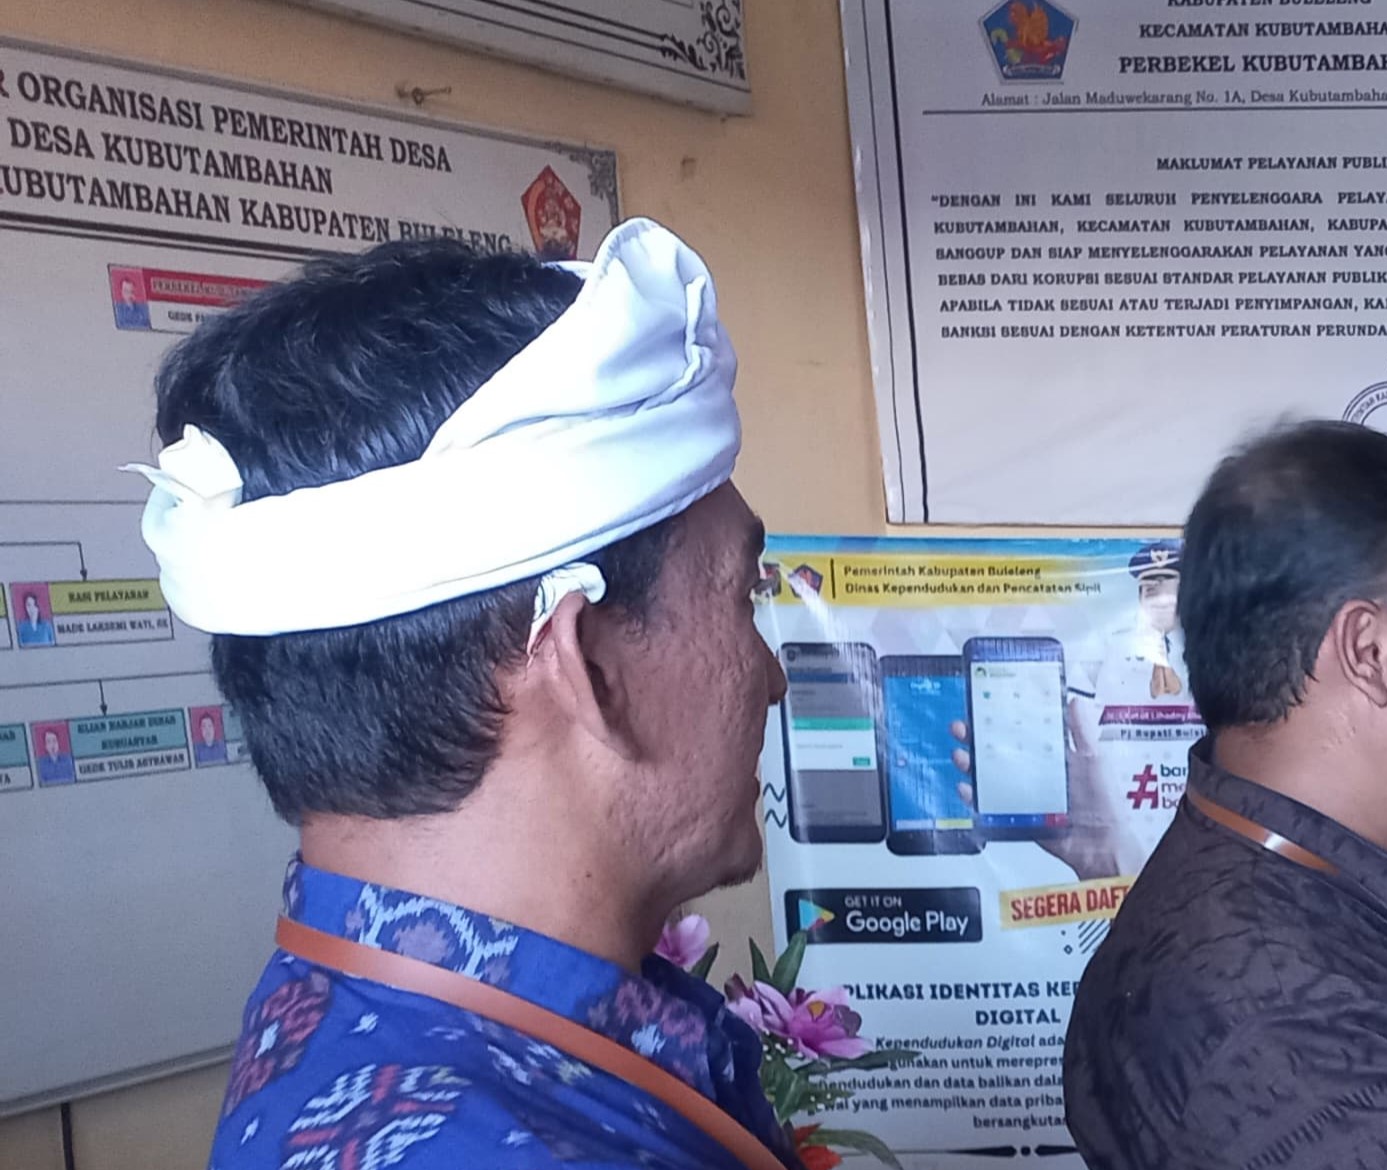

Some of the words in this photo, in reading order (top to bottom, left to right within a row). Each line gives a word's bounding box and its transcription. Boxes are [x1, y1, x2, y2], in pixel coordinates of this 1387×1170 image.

[1139, 22, 1249, 38] KECAMATAN
[1119, 55, 1235, 74] PERBEKEL
[982, 92, 1029, 107] Alamat
[1042, 91, 1081, 106] Jalan
[1086, 89, 1192, 107] Maduwekarang
[1196, 90, 1218, 104] No.
[1251, 89, 1284, 103] Desa
[17, 71, 205, 131] ORGANISASI
[212, 105, 385, 161] PEMERINTAH
[389, 137, 452, 173] DESA
[7, 116, 95, 160] DESA
[101, 132, 333, 195] KUBUTAMBAHAN
[1156, 157, 1243, 170] MAKLUMAT
[1248, 157, 1338, 170] PELAYANAN
[0, 165, 231, 224] UBUTAMBAHAN
[238, 198, 391, 243] KABUPATEN
[1015, 193, 1036, 206] INI
[1051, 193, 1091, 206] KAMI
[1105, 192, 1177, 206] SELURUH
[1191, 191, 1323, 206] PENYELENGGARA
[934, 220, 1065, 235] KUBUTAMBAHAN,
[1077, 219, 1171, 233] KECAMATAN
[1184, 218, 1315, 234] KUBUTAMBAHAN,
[936, 247, 1005, 261] SANGGUP
[1011, 247, 1042, 260] DAN
[1048, 247, 1082, 260] SIAP
[1088, 246, 1253, 260] MENYELENGGARAKAN
[1259, 245, 1349, 259] PELAYANAN
[938, 273, 986, 287] BEBAS
[991, 273, 1028, 286] DARI
[1033, 273, 1099, 286] KORUPSI
[1104, 272, 1158, 285] SESUAI
[1163, 271, 1234, 285] STANDAR
[1238, 271, 1327, 285] PELAYANAN
[1332, 271, 1387, 284] PUBLIK
[939, 299, 1002, 313] APABILA
[1008, 299, 1055, 312] TIDAK
[1060, 298, 1114, 311] SESUAI
[1119, 298, 1159, 311] ATAU
[1164, 298, 1230, 311] TERJADI
[1235, 297, 1359, 312] PENYIMPANGAN,
[941, 325, 996, 338] SANKSI
[1001, 325, 1055, 338] SESUAI
[1060, 325, 1121, 338] DENGAN
[1126, 325, 1216, 338] KETENTUAN
[1221, 324, 1311, 337] PERATURAN
[844, 565, 915, 577] Pemerintah
[918, 566, 985, 578] Kabupaten
[988, 566, 1041, 579] Buleleng
[845, 583, 879, 594] Dinas
[883, 583, 975, 596] Kependudukan
[977, 583, 1001, 594] dan
[1003, 583, 1072, 595] Pencatatan
[845, 895, 870, 908] GET
[872, 895, 881, 907] IT
[884, 894, 902, 908] ON
[1011, 888, 1082, 922] SEGERA
[846, 911, 921, 936] Google
[926, 910, 968, 936] Play
[843, 983, 925, 1000] PLIKASI
[930, 982, 1040, 1000] IDENTITAS
[975, 1008, 1062, 1026] DIGITAL
[876, 1035, 983, 1052] Kependudukan
[986, 1034, 1035, 1050] Digital
[887, 1056, 948, 1072] gunakan
[951, 1054, 993, 1069] untuk
[914, 1075, 940, 1089] dan
[943, 1075, 975, 1089] data
[851, 1098, 888, 1114] yang
[891, 1096, 986, 1112] menampilkan
[988, 1095, 1021, 1109] data
